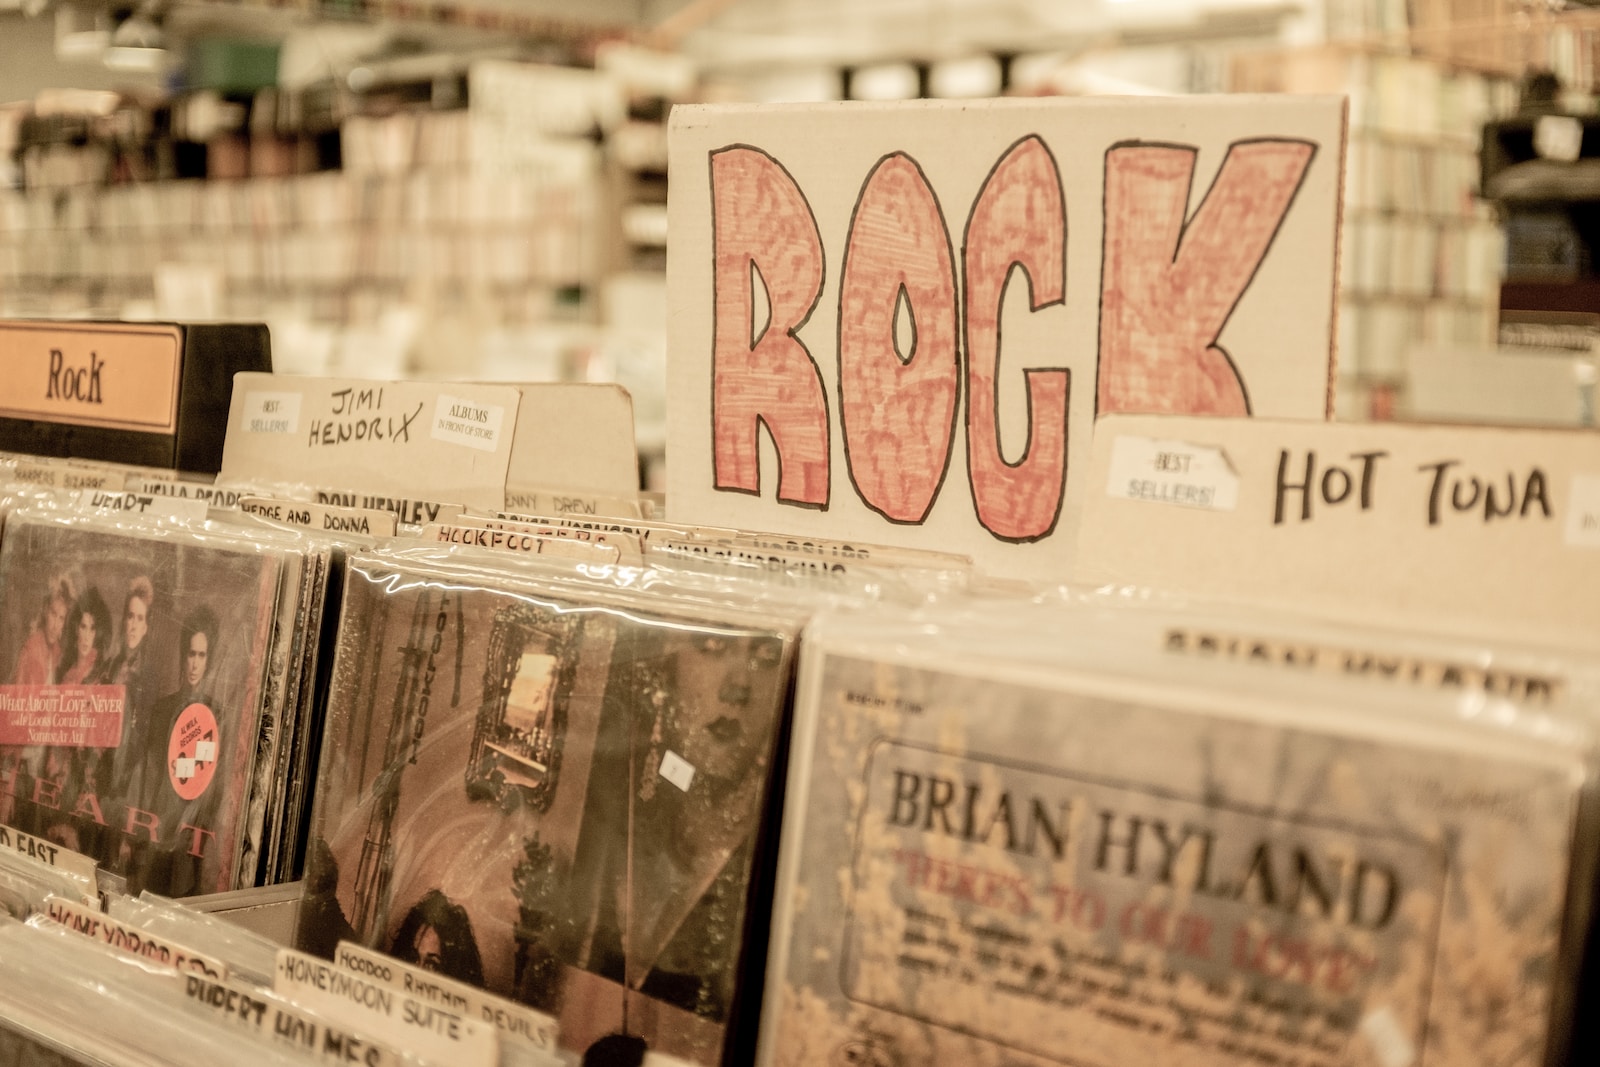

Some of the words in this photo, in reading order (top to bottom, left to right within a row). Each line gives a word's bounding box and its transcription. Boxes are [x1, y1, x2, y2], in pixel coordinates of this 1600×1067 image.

[709, 132, 1320, 544] ROCK
[46, 348, 105, 404] Rock
[331, 387, 383, 415] JIMI
[448, 404, 489, 423] ALBUMS
[308, 402, 424, 447] HENDRIX
[438, 419, 446, 429] IN
[446, 420, 465, 434] FRONT
[466, 424, 474, 435] OF
[474, 427, 493, 441] STORE
[1272, 448, 1390, 527] HOT
[1417, 459, 1553, 527] TUNA
[553, 497, 597, 515] DREW
[287, 510, 311, 525] AND
[323, 513, 370, 534] DONNA
[26, 693, 60, 712] ABOUT
[60, 694, 86, 713] LOVE
[90, 693, 122, 713] NEVER
[180, 725, 202, 748] RECORDS
[17, 833, 58, 866] EAST
[886, 768, 1073, 862] BRIAN
[1092, 810, 1400, 933] HYLAND
[340, 950, 392, 983] HOODOO
[481, 1005, 547, 1049] DEVILS
